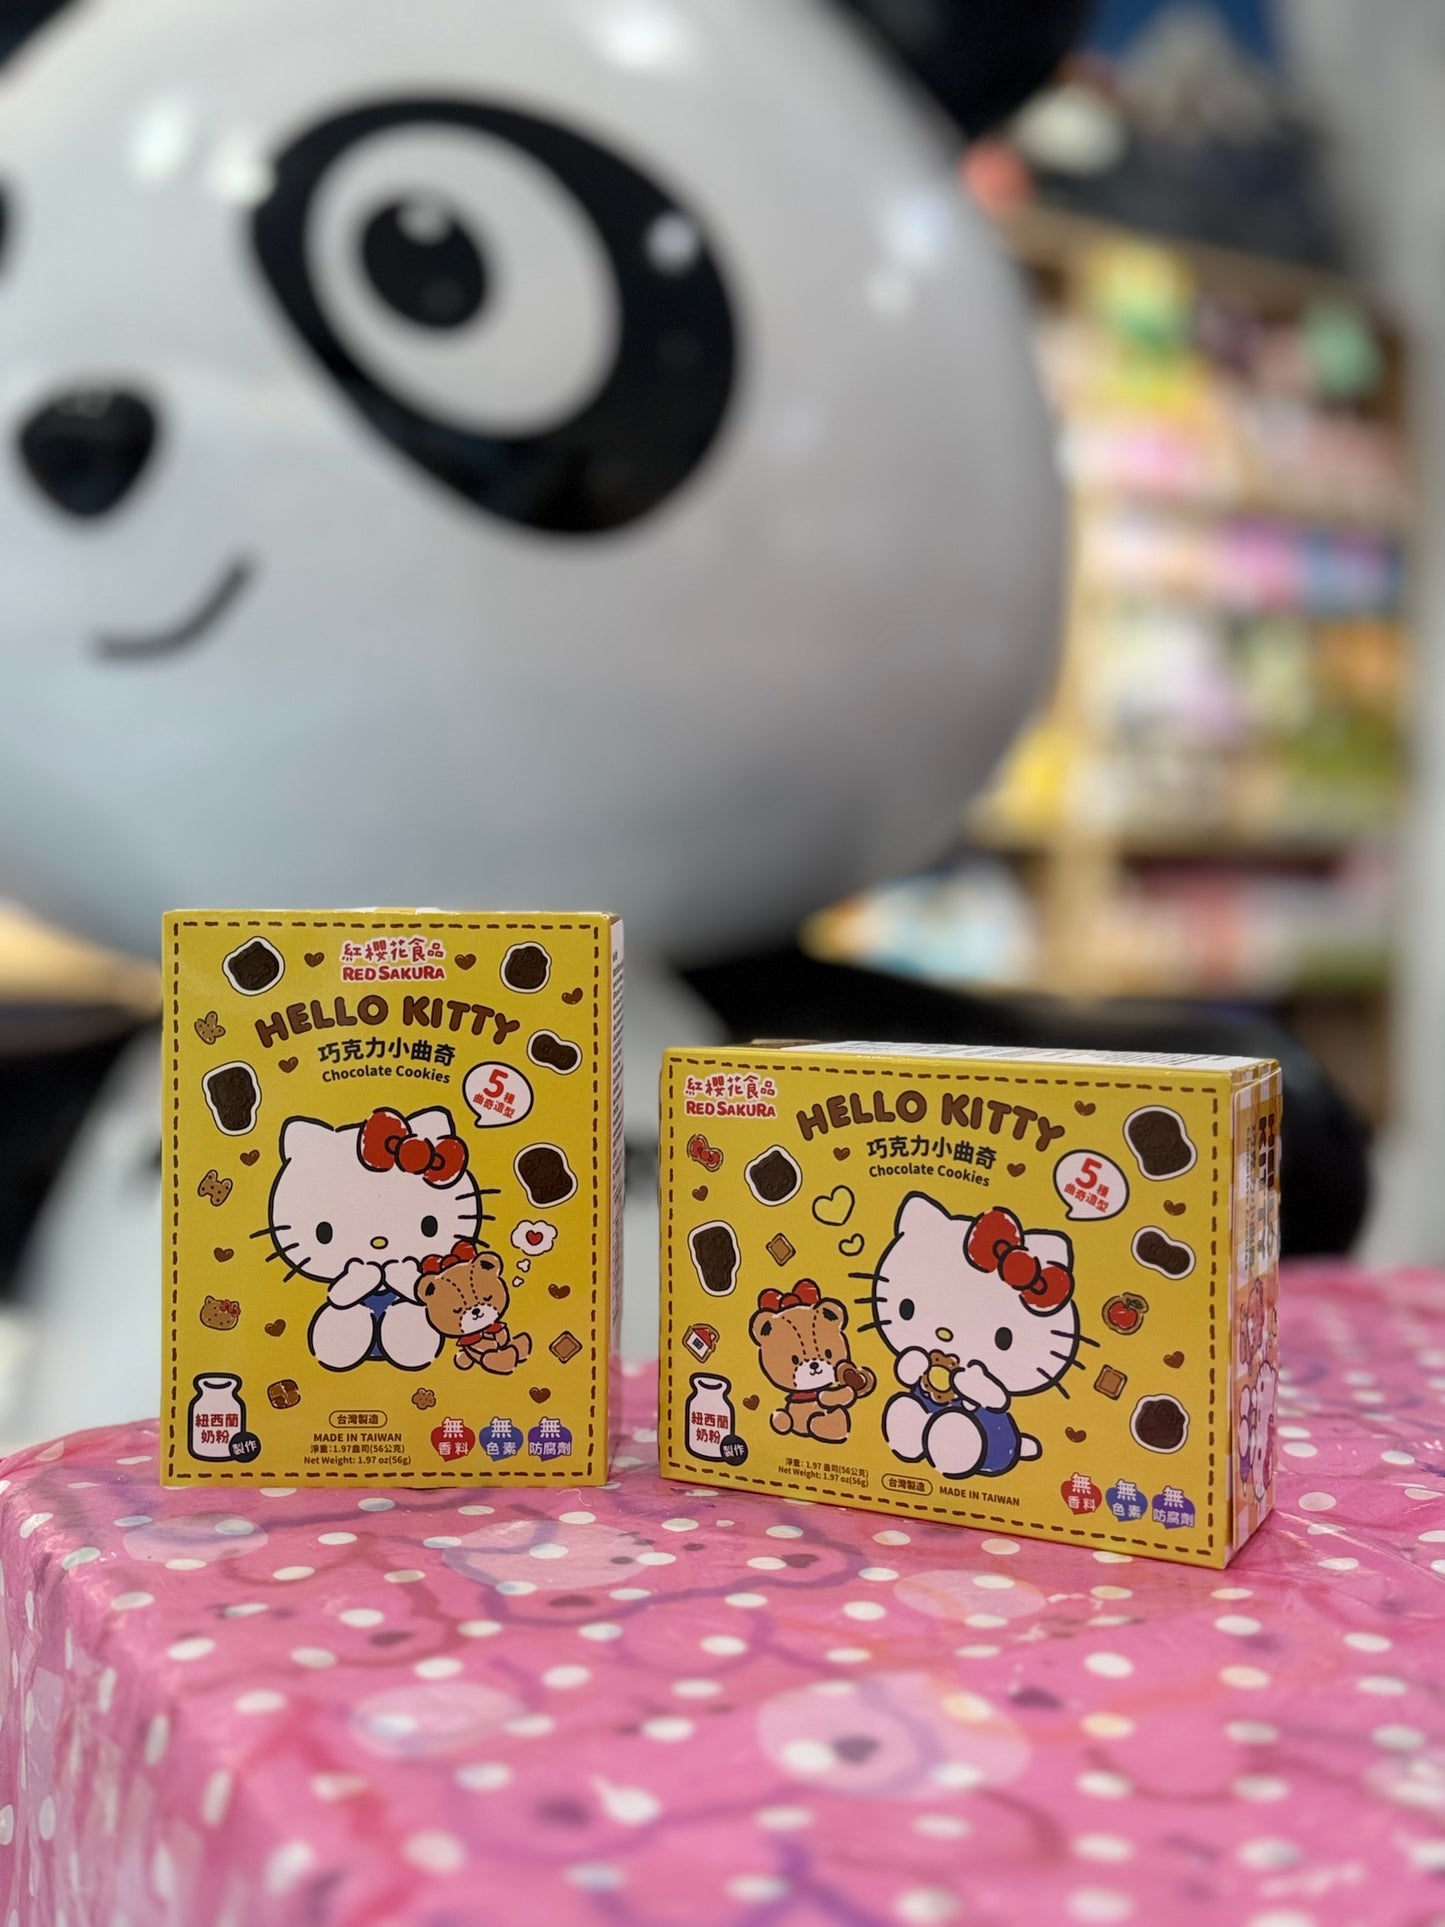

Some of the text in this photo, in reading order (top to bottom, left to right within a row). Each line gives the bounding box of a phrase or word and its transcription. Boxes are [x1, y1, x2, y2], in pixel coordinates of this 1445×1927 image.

[342, 938, 445, 961] 紅櫻花食品
[342, 965, 446, 981] RED SAKURA
[254, 994, 521, 1048] HELLO KITTY
[317, 1036, 456, 1067] 巧克力小曲奇
[321, 1063, 452, 1085] Chocolate Cookies
[685, 1074, 776, 1099] 紅櫻花食品
[473, 1092, 516, 1119] 曲奇造型
[686, 1100, 776, 1118] RED SAKURA
[796, 1090, 1066, 1153] HELLO KITTY
[866, 1134, 998, 1170] 巧克力小曲奇
[868, 1162, 991, 1188] Chocolate Cookies
[195, 1413, 239, 1428] 紐西蘭
[336, 1413, 379, 1426] 台灣製造
[443, 1418, 464, 1438] 無
[491, 1418, 512, 1438] 無
[540, 1418, 561, 1438] 無
[691, 1411, 729, 1429] 紐西蘭
[201, 1429, 230, 1444] 奶粉
[313, 1432, 402, 1443] MADE IN TAIWAN
[696, 1427, 721, 1445] 奶粉
[232, 1440, 257, 1456] 製作
[438, 1441, 469, 1456] 香料
[486, 1441, 517, 1456] 色素
[529, 1441, 571, 1456] 防腐劑
[722, 1443, 745, 1458] 製作
[303, 1455, 412, 1467] Net Weight: 1.97 oz(56g)
[778, 1465, 791, 1475] Net
[792, 1467, 822, 1480] Weight:
[822, 1471, 840, 1482] 1.97
[888, 1477, 926, 1493] 台灣製造
[1072, 1473, 1092, 1495] 無
[1116, 1480, 1137, 1501] 無
[939, 1485, 1020, 1507] MADE IN TAIWAN
[1067, 1495, 1096, 1511] 香料
[1163, 1486, 1184, 1508] 無
[1112, 1502, 1141, 1518] 色素
